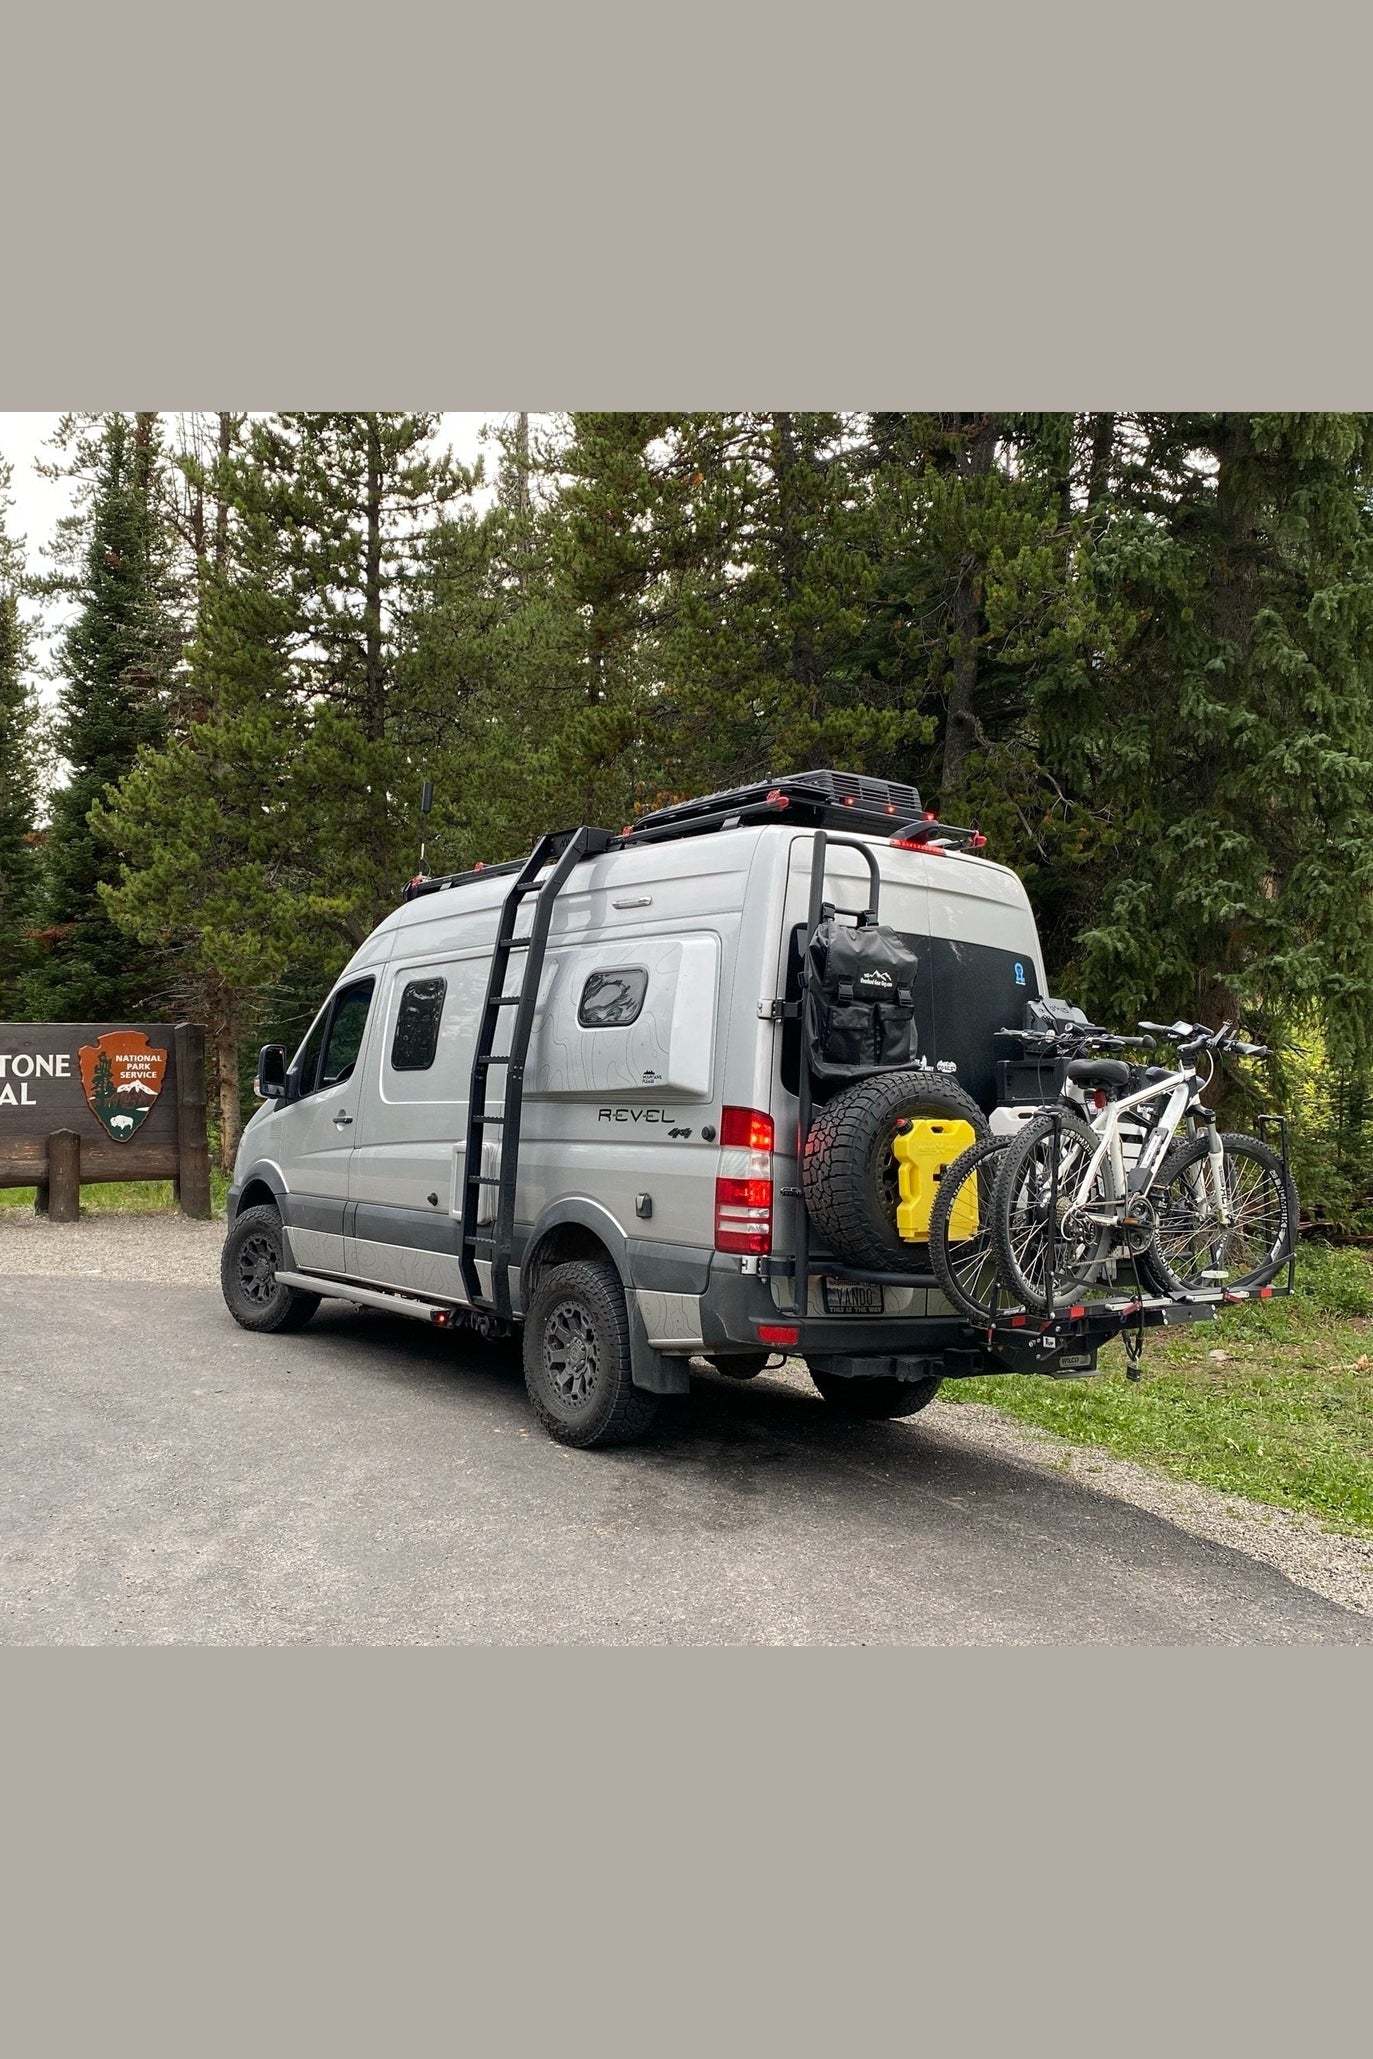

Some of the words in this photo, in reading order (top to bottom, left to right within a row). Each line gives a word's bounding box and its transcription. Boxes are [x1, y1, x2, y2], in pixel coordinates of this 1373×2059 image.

[115, 1054, 162, 1062] NATIONAL
[120, 1071, 157, 1079] SERVICE
[0, 1082, 37, 1105] AL
[597, 1108, 676, 1123] REVEL
